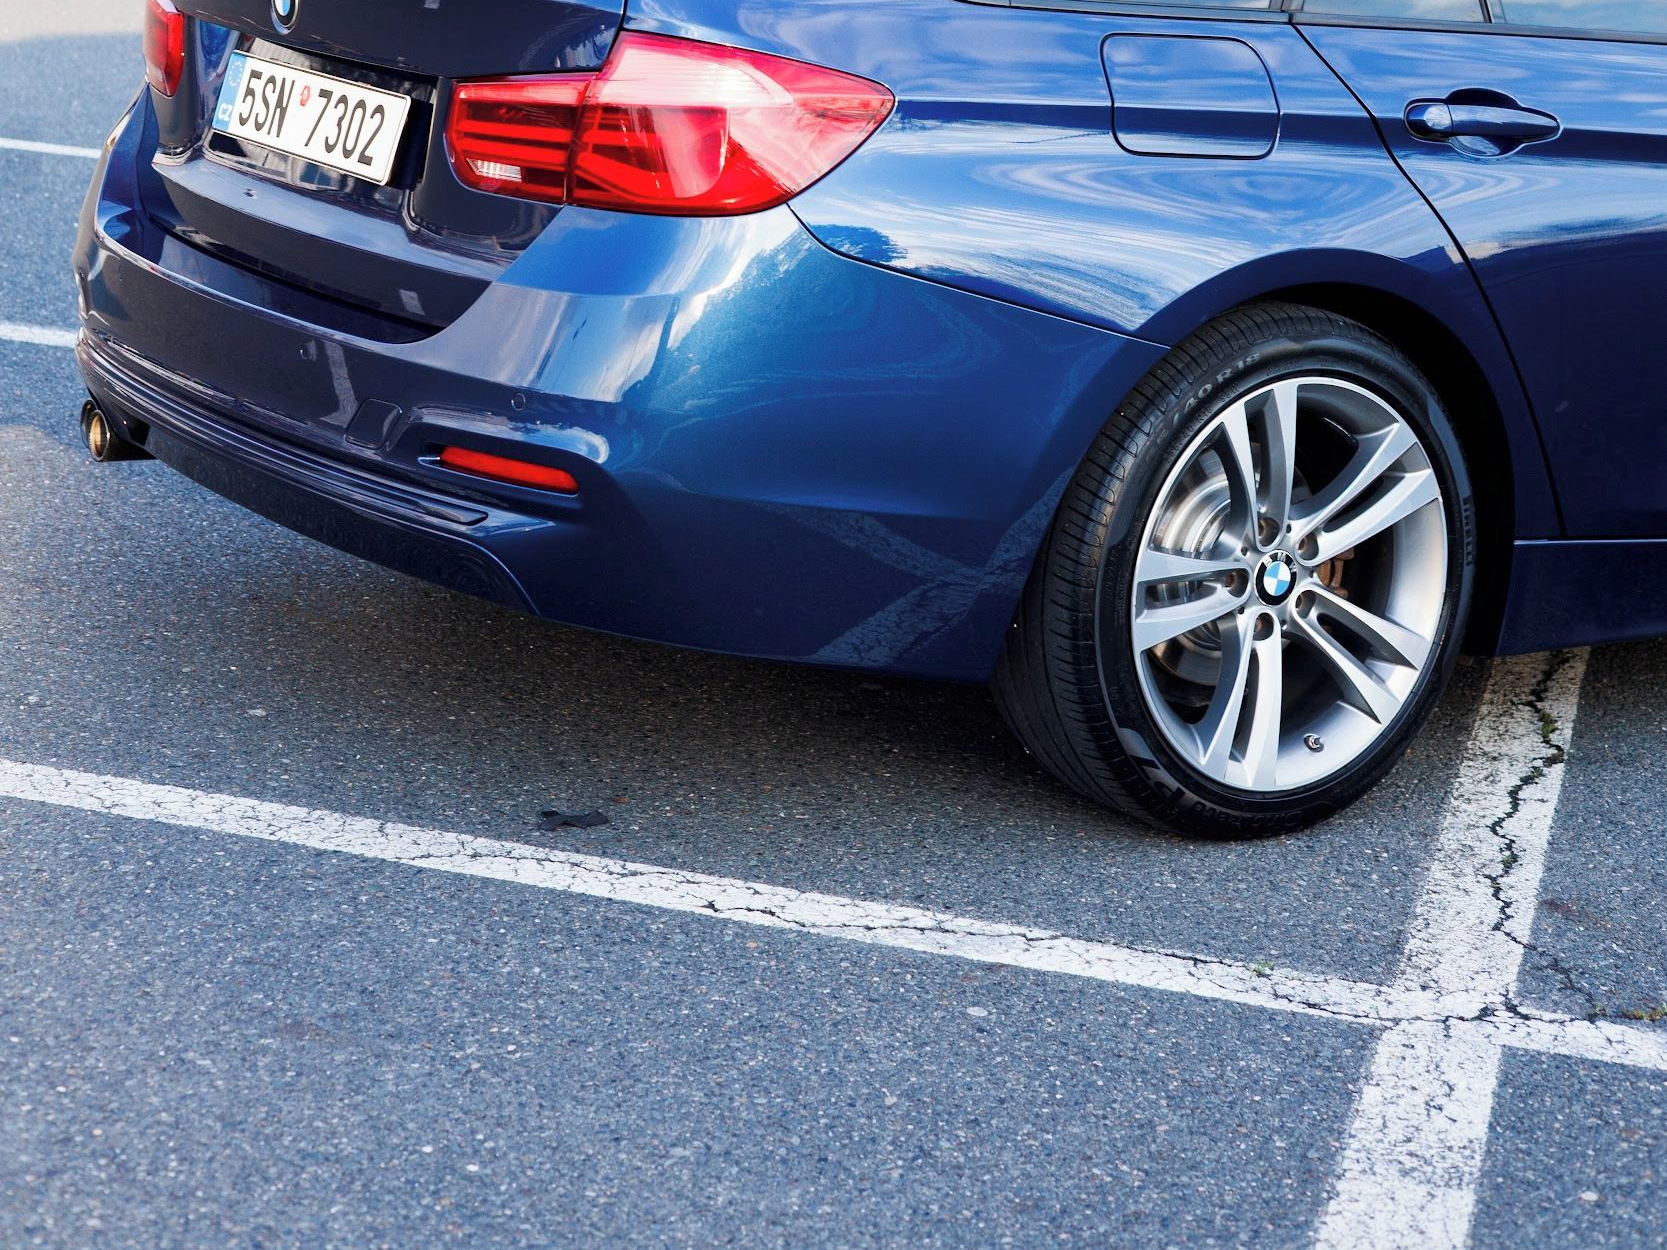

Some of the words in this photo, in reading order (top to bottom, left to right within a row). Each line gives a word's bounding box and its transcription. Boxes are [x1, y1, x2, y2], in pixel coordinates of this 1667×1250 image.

[217, 103, 232, 121] CZ
[239, 69, 296, 138] 5SN
[304, 88, 385, 166] 7302
